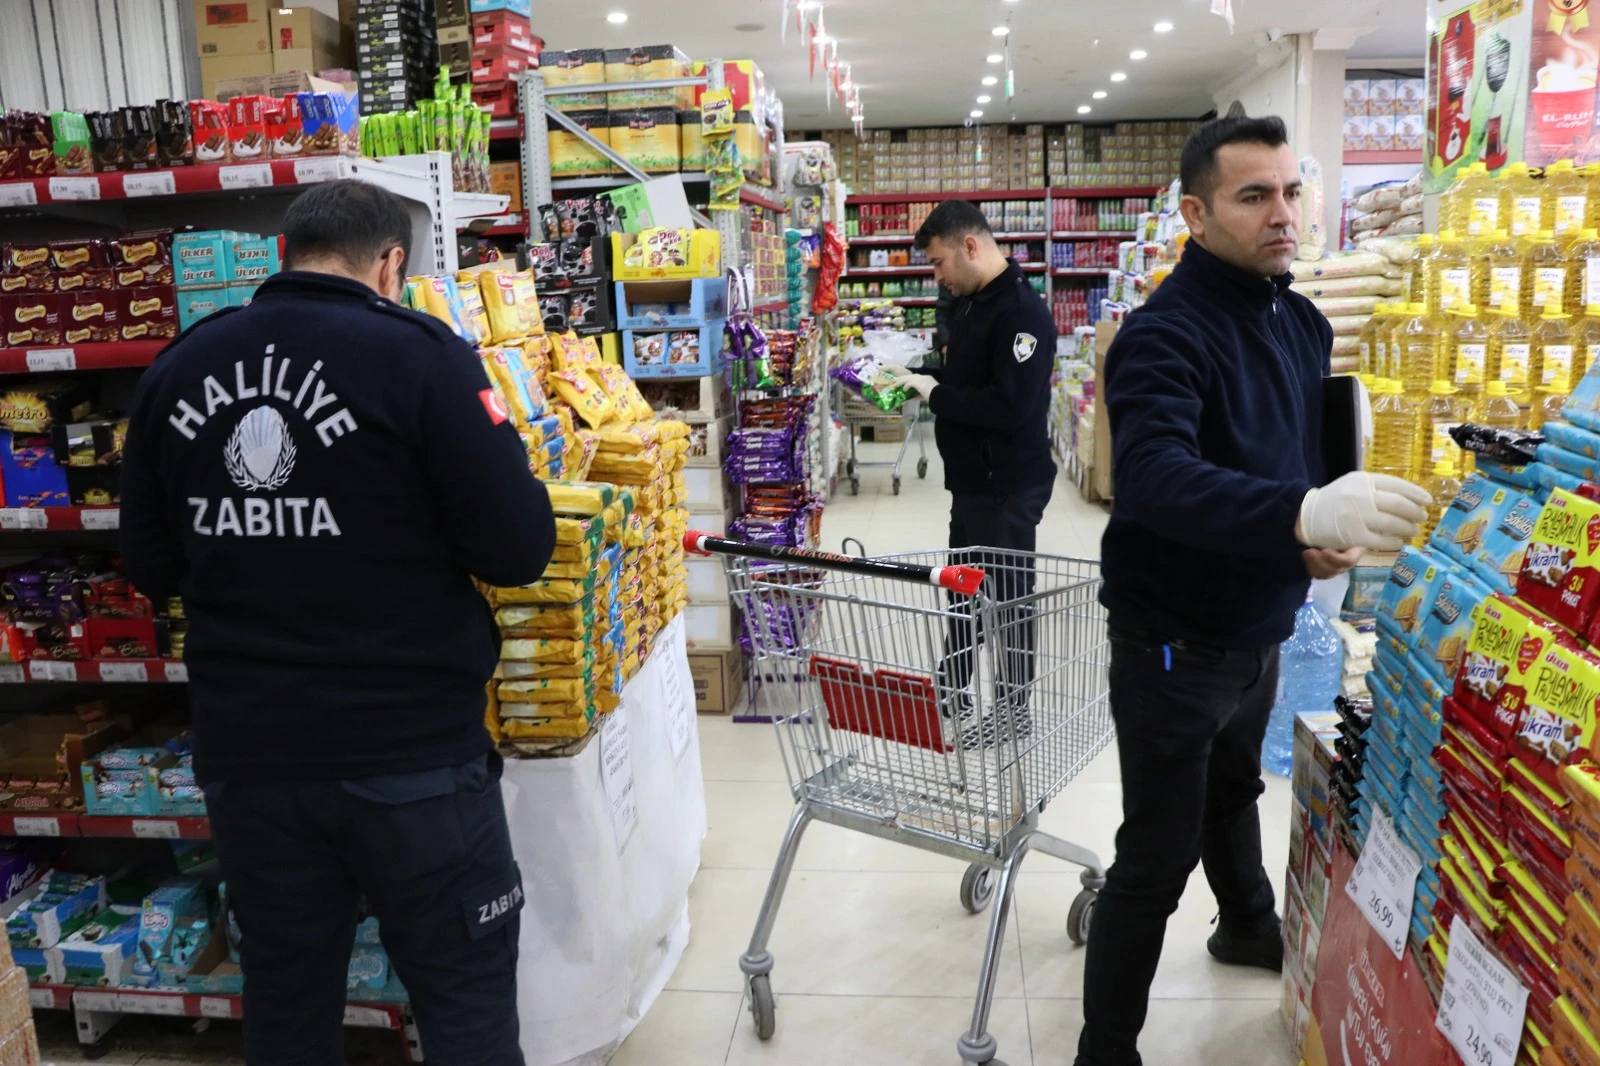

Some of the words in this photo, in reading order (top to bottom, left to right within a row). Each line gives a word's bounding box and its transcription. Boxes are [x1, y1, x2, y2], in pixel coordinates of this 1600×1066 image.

[180, 245, 214, 258] ÜLKER
[235, 266, 269, 278] ÜLKER
[168, 344, 358, 448] HALİLİYE
[187, 497, 342, 537] ZABITA
[1545, 650, 1570, 672] ÜLKER
[1524, 716, 1562, 740] ikram
[1367, 889, 1394, 929] 26,99
